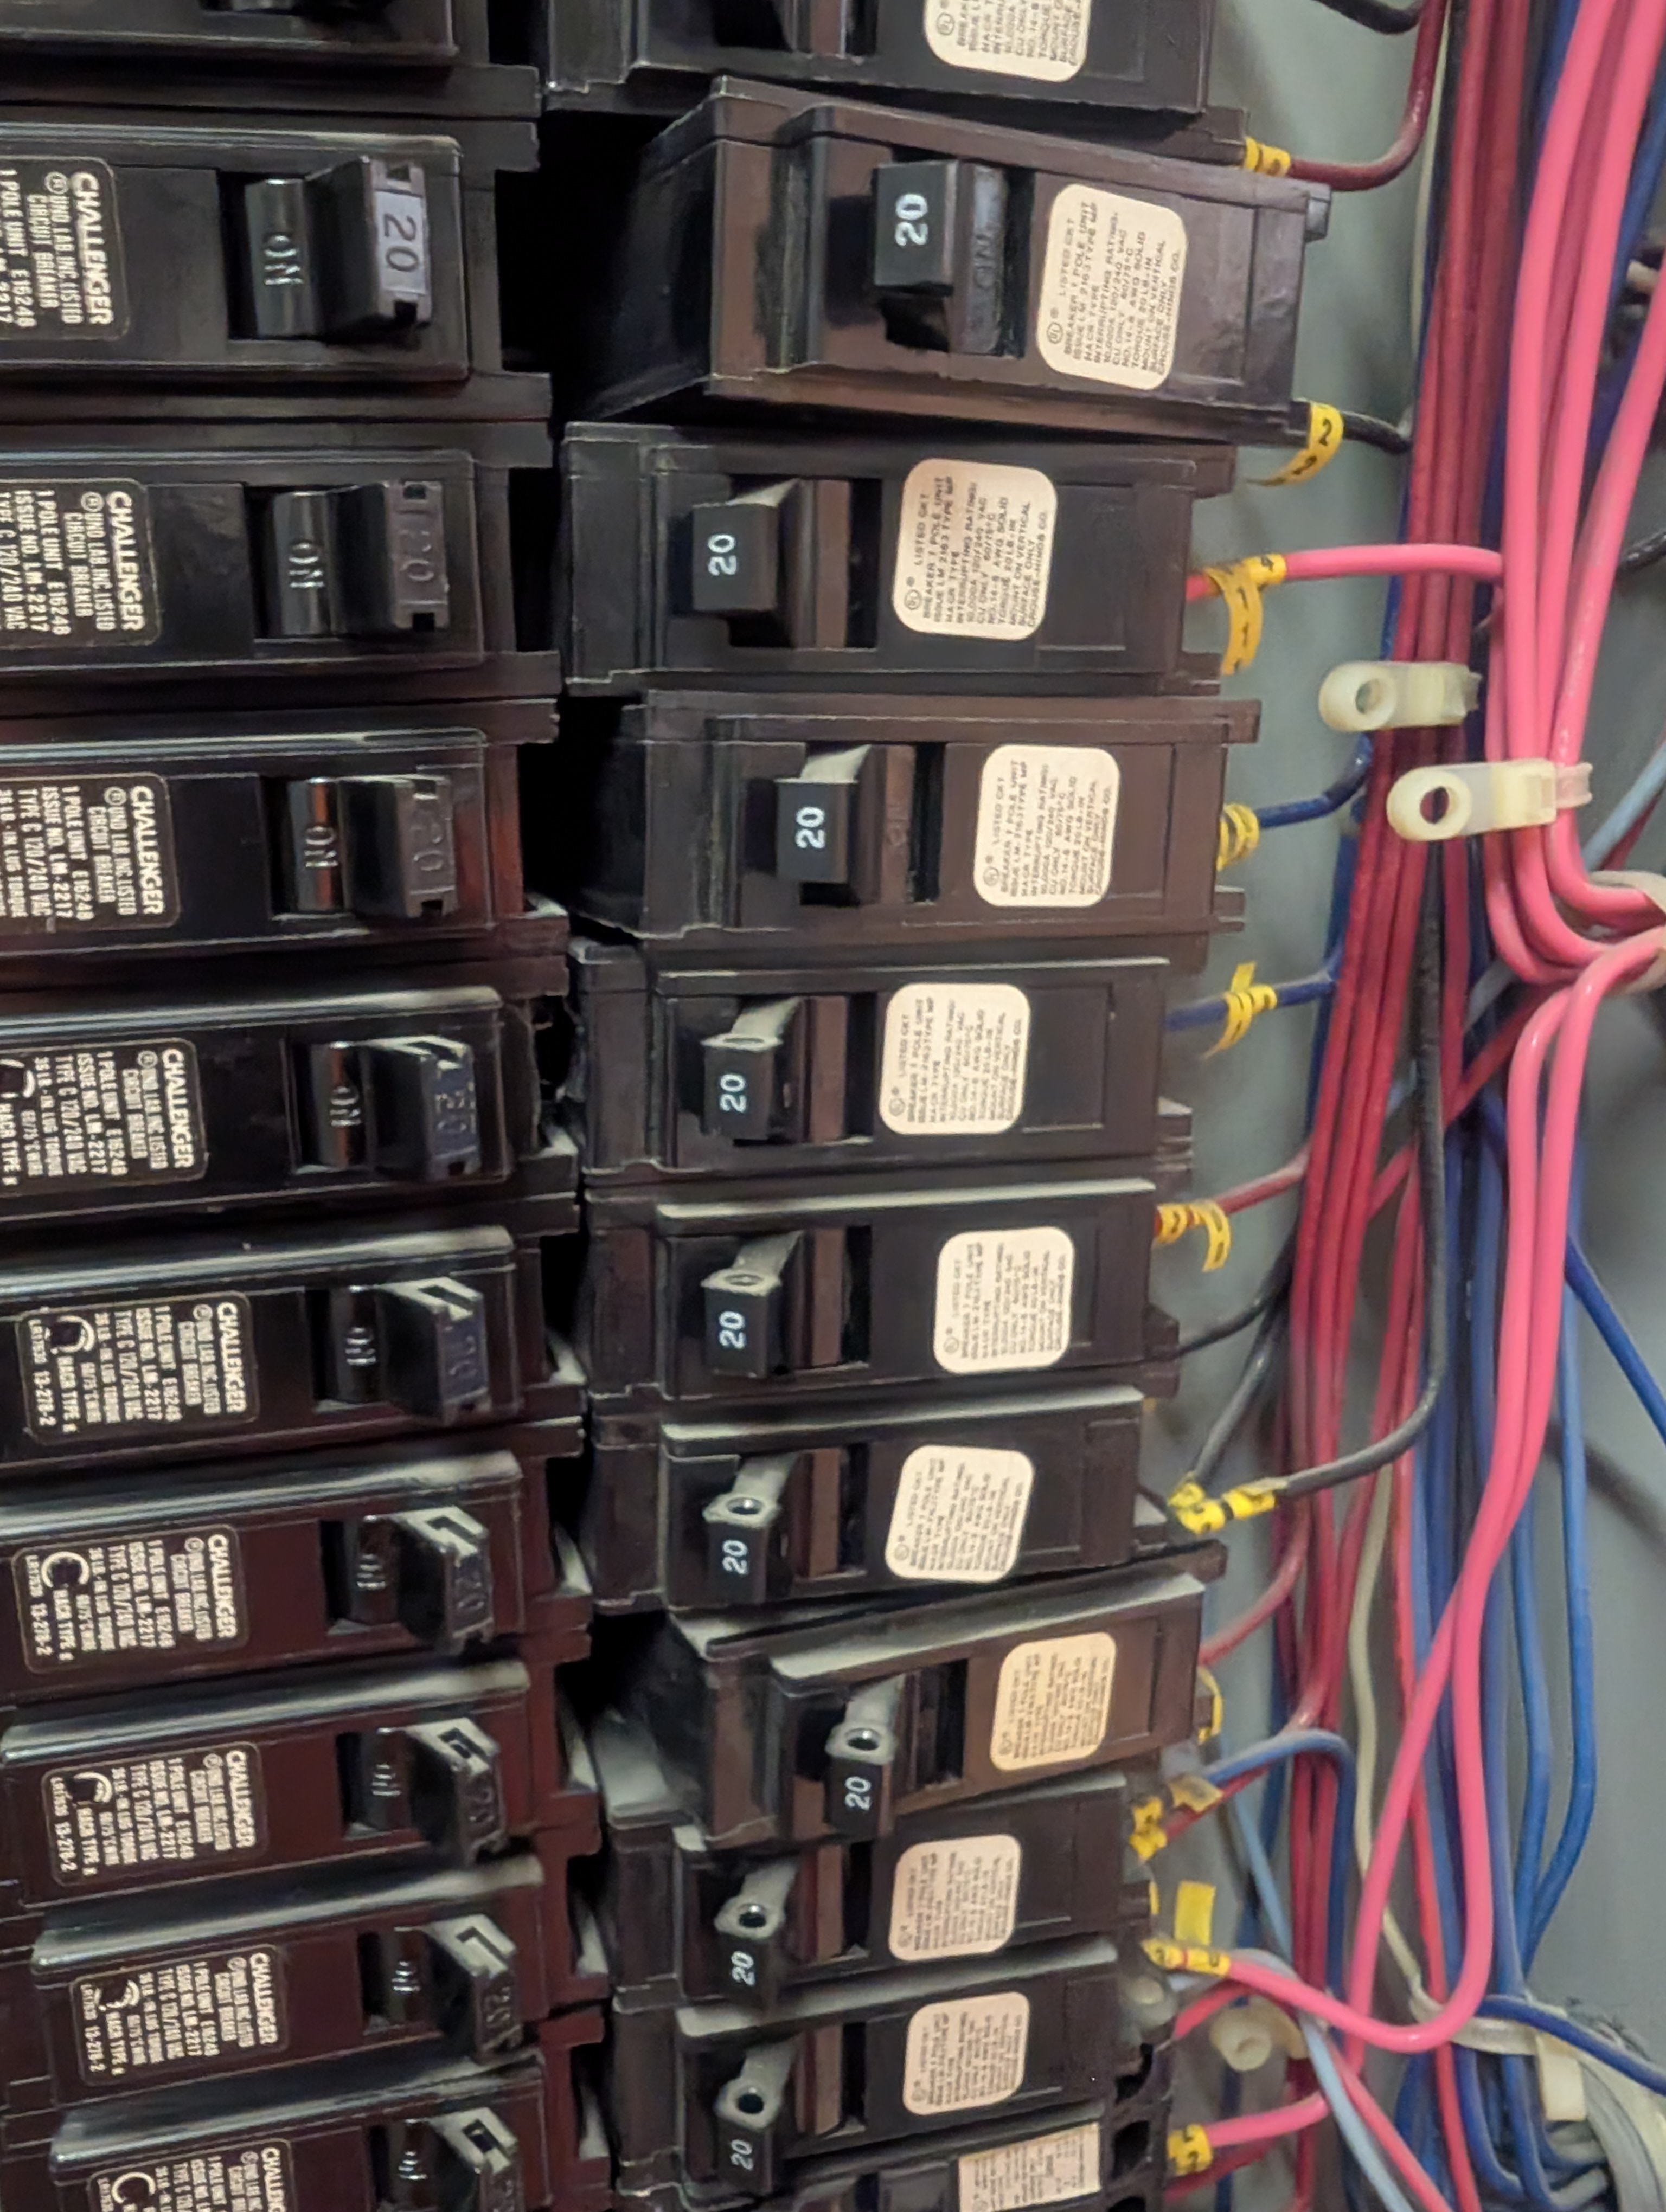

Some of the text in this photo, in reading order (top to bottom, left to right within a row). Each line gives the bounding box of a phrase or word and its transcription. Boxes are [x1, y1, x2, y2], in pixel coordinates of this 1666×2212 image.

[0, 181, 23, 217] POLE
[3, 222, 28, 256] UNIT
[895, 194, 928, 246] 20
[71, 172, 112, 324] CHALLENGER
[264, 234, 305, 285] ON
[383, 213, 418, 272] 20
[1072, 241, 1085, 277] POLE
[1318, 417, 1334, 446] 2
[14, 490, 37, 531] ISSUE
[36, 501, 61, 534] POLE
[929, 512, 940, 545] POLE
[941, 500, 952, 530] TYPE
[42, 538, 65, 570] UNIT
[63, 512, 88, 558] CIRCUIT
[0, 544, 25, 602] 120/240
[106, 491, 145, 630] CHALLENGER
[289, 544, 325, 588] ON
[708, 534, 736, 576] 20
[949, 551, 959, 580] TYPE
[3, 606, 29, 629] VAC
[47, 581, 72, 635] E16248
[41, 786, 62, 824] ISSUE
[63, 796, 84, 827] POLE
[67, 830, 88, 860] UNIT
[304, 825, 339, 869] ON
[796, 807, 825, 848] 20
[17, 788, 53, 916] TYPE C 120/240 VAC
[129, 786, 165, 915] CHALLENGER
[71, 870, 95, 921] E16248
[54, 1054, 76, 1083] TYPE
[76, 1053, 97, 1088] ISSUE
[98, 1060, 118, 1090] POLE
[161, 1048, 195, 1168] CHALLENGER
[330, 1086, 363, 1127] ON
[720, 1074, 746, 1113] 20
[1, 1140, 21, 1172] TYPE
[720, 1311, 745, 1348] 20
[216, 1301, 246, 1413] CHALLENGER
[722, 1540, 747, 1574] 20
[207, 1533, 238, 1638] CHALLENGER
[225, 1749, 256, 1848] CHALLENGER
[845, 1776, 871, 1810] 20
[731, 1951, 754, 1985] 20
[248, 1951, 278, 2045] CHALLENGER
[731, 2139, 753, 2170] 20
